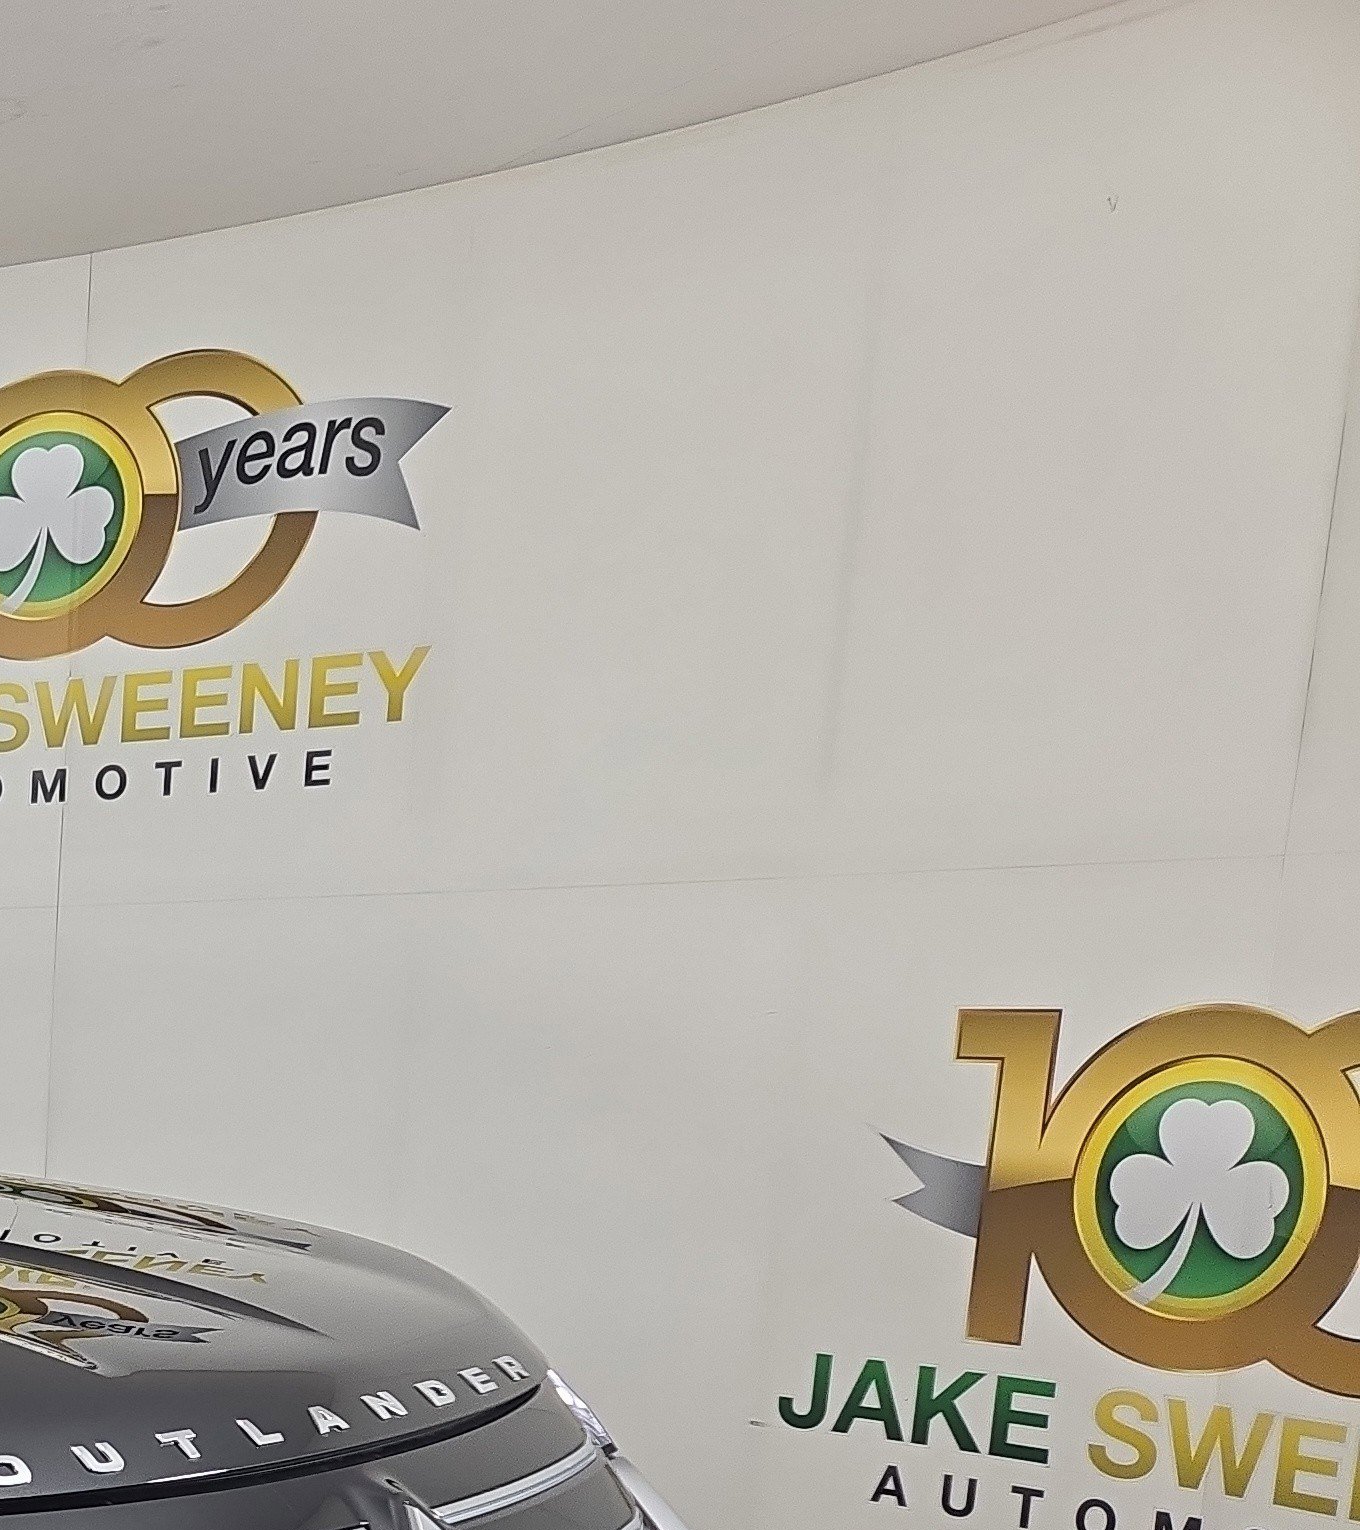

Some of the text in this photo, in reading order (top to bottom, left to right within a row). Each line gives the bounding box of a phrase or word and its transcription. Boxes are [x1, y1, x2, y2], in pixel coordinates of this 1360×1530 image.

[193, 415, 387, 515] years
[779, 1353, 1360, 1522] JAKE SWE
